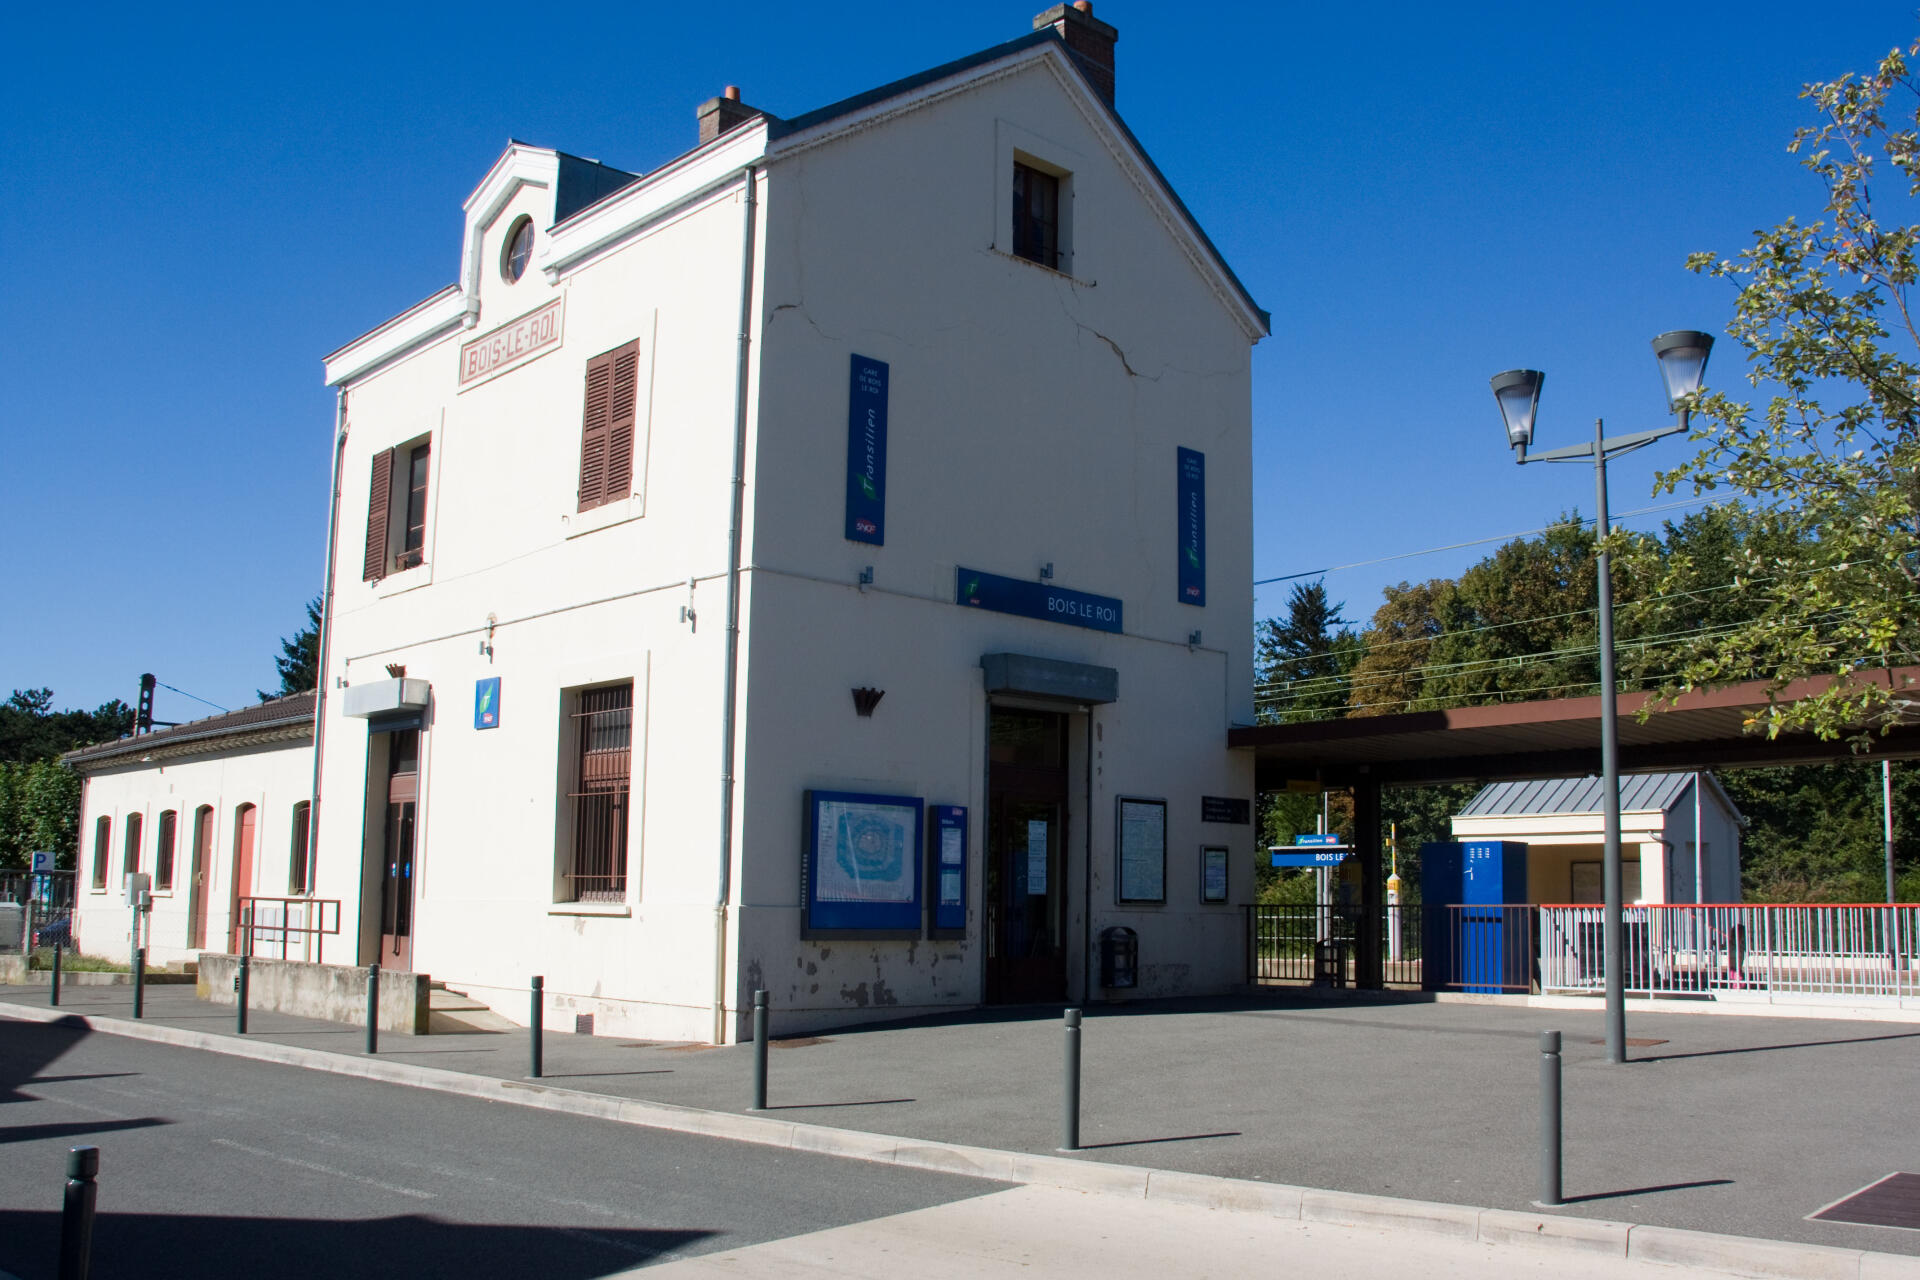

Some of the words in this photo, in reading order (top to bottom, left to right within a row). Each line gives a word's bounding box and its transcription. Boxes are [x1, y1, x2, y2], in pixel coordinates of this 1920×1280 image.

[863, 407, 876, 491] Transilien
[1048, 596, 1077, 616] BOIS
[1080, 604, 1093, 618] LE
[1096, 606, 1117, 623] ROI
[35, 854, 47, 869] P
[1315, 853, 1334, 861] BOIS
[1335, 853, 1345, 861] LE
